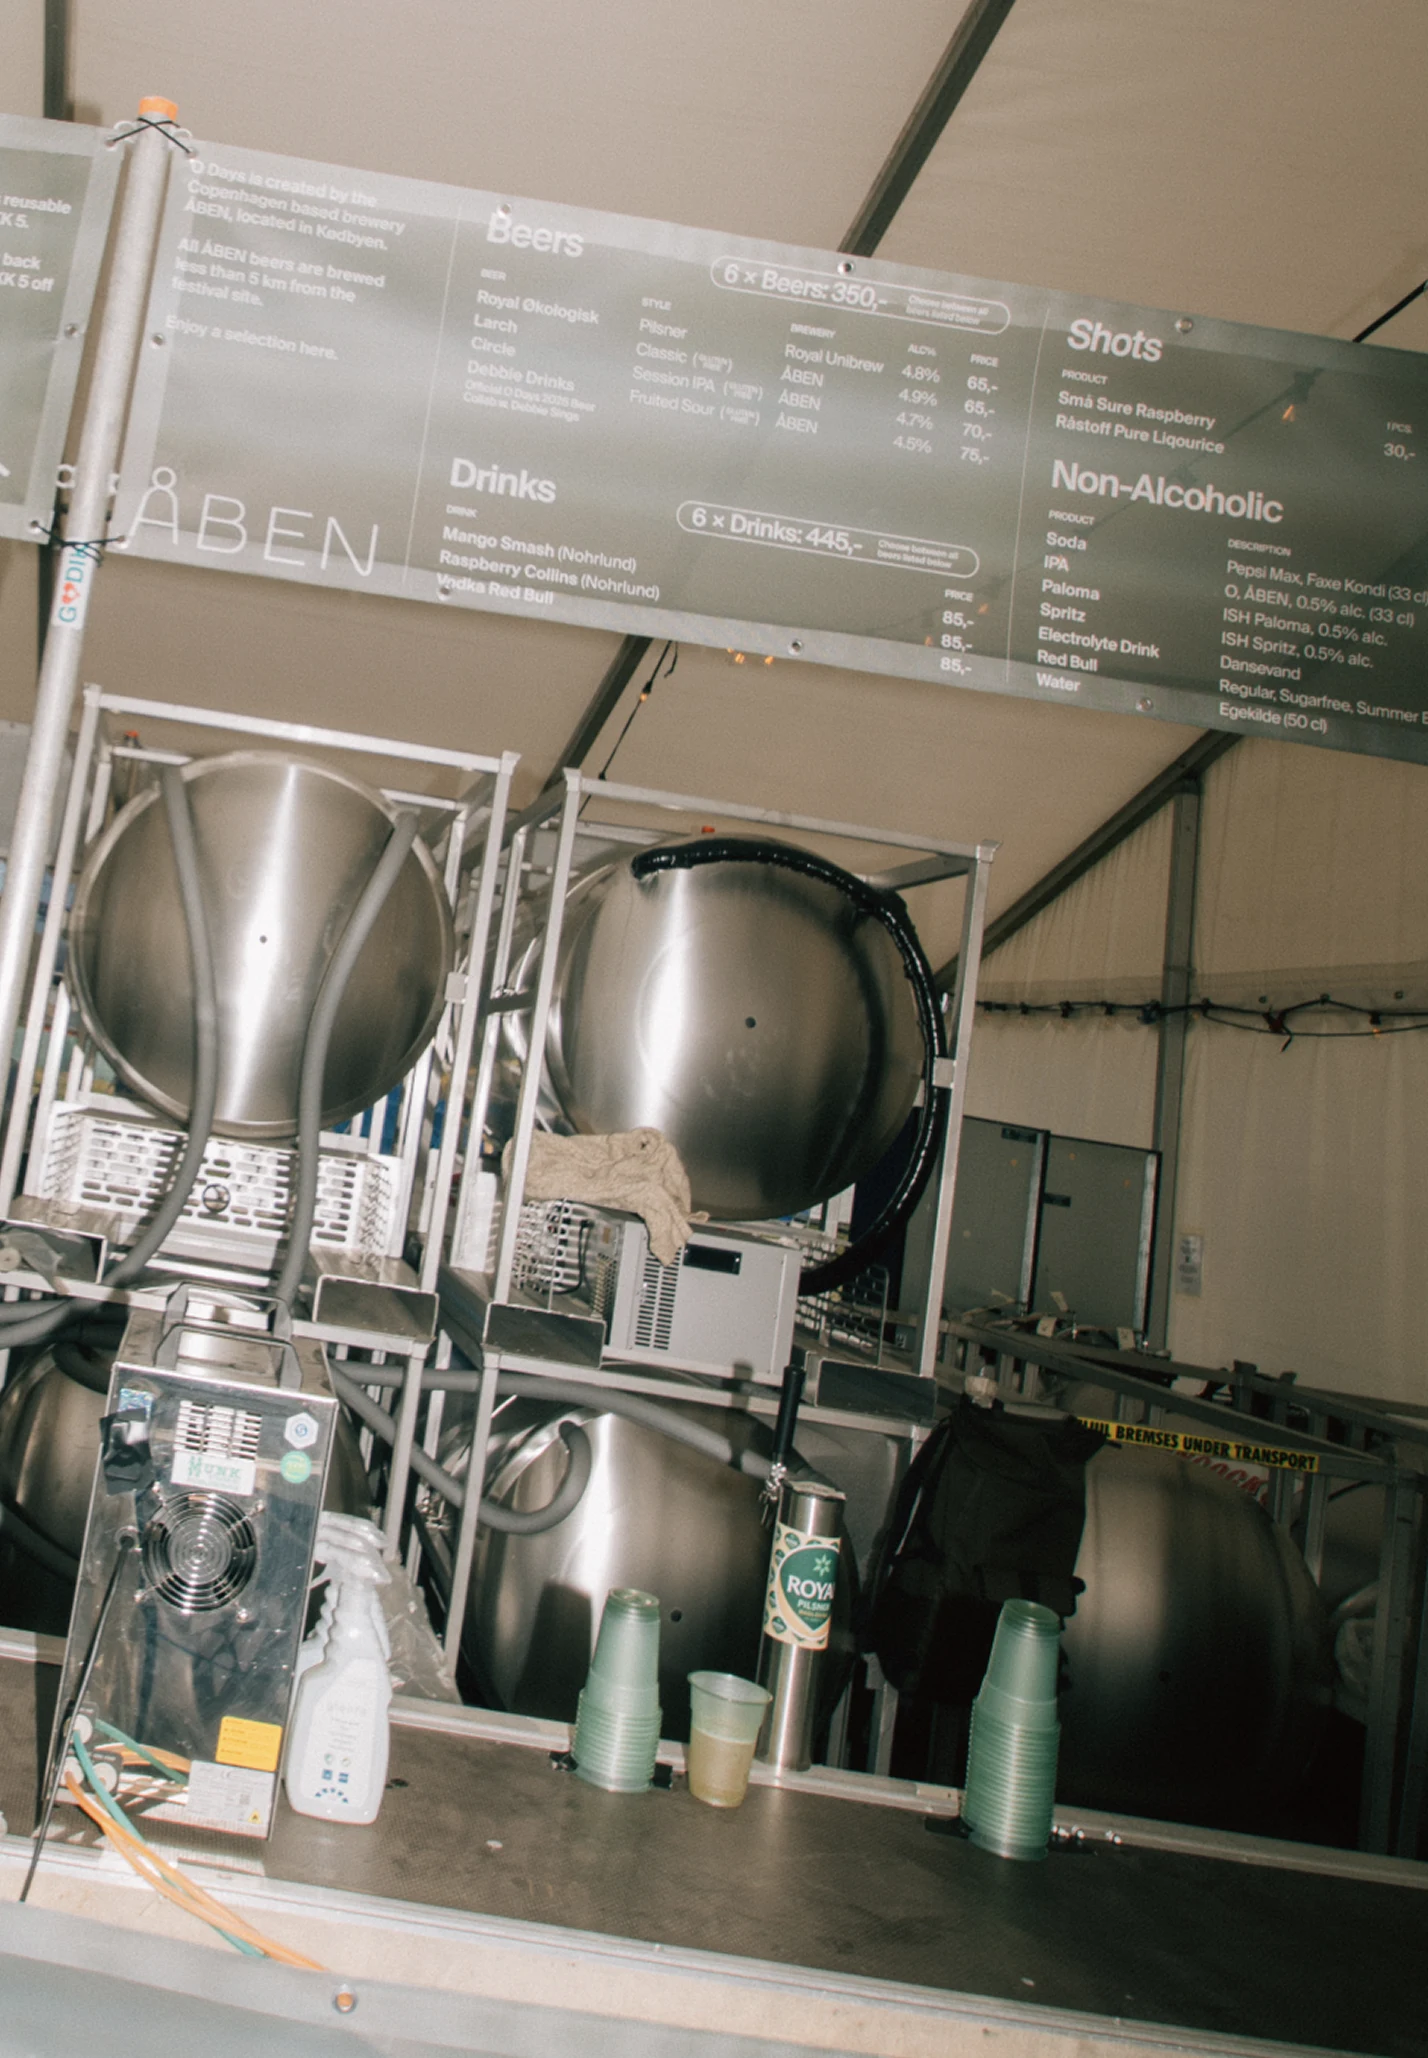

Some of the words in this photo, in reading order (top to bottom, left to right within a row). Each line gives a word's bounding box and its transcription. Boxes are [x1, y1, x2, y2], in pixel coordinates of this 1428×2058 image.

[208, 163, 246, 183] Days
[249, 174, 262, 186] is
[265, 177, 326, 198] created
[329, 186, 349, 204] by
[351, 191, 377, 207] the
[4, 196, 72, 214] reusable
[184, 197, 233, 222] ÅBEN,
[236, 207, 295, 231] located
[299, 223, 313, 235] in
[187, 180, 286, 210] Copenhagen
[291, 200, 339, 221] based
[342, 210, 406, 235] brewery
[486, 211, 584, 258] Beers
[3, 252, 41, 270] back
[177, 238, 199, 253] All
[201, 239, 247, 263] ÅBEN
[249, 251, 294, 271] beers
[297, 262, 323, 276] are
[327, 264, 385, 287] brewed
[18, 274, 30, 289] 5
[31, 278, 54, 292] off
[172, 277, 228, 299] festival
[232, 289, 264, 306] site.
[175, 256, 206, 276] less
[210, 264, 245, 282] than
[249, 271, 260, 285] 5
[262, 274, 286, 290] km
[290, 279, 327, 298] from
[330, 285, 356, 303] the
[724, 264, 738, 283] 6
[761, 270, 829, 299] Beers:
[831, 283, 888, 312] 350,-
[477, 289, 520, 310] Royal
[522, 298, 599, 324] Økologisk
[474, 314, 517, 333] Larch
[640, 318, 688, 339] Pilsner
[166, 315, 208, 337] Enjoy
[211, 326, 222, 337] a
[224, 327, 296, 352] selection
[300, 341, 338, 360] here.
[471, 336, 516, 357] Circle
[1067, 319, 1163, 363] Shots
[636, 342, 687, 364] Classic
[784, 344, 823, 364] Royal
[826, 350, 885, 373] Unibrew
[970, 354, 999, 367] PRICE
[467, 360, 522, 382] Debbie
[526, 370, 574, 391] Drinks
[633, 366, 689, 388] Session
[692, 376, 715, 392] IPA
[780, 365, 824, 387] ÅBEN
[901, 365, 940, 384] 4.8%
[967, 376, 998, 394] 65,-
[1062, 369, 1107, 385] PRODUCT
[630, 389, 679, 410] Fruited
[681, 398, 715, 415] Sour
[778, 389, 821, 411] ÅBEN
[899, 389, 937, 407] 4.9%
[964, 400, 995, 418] 65,-
[1058, 390, 1093, 409] Små
[1097, 397, 1132, 417] Sure
[1136, 403, 1216, 430] Raspberry
[775, 412, 818, 434] ÅBEN
[896, 413, 933, 430] 4.7%
[962, 423, 992, 441] 70,-
[1055, 414, 1111, 437] Råstoff
[1114, 424, 1149, 442] Pure
[1153, 429, 1225, 454] Liqourice
[1384, 443, 1416, 460] 30,-
[450, 457, 556, 504] Drinks
[1052, 459, 1284, 525] Non-Alcoholic
[126, 466, 378, 577] ÅBEN
[1048, 510, 1095, 526] PRODUCT
[692, 508, 706, 527] 6
[730, 514, 801, 544] Drinks:
[805, 527, 862, 556] 445,-
[1046, 531, 1087, 552] Soda
[442, 526, 497, 549] Mango
[501, 536, 554, 558] Smash
[558, 546, 636, 574] (Nohrlund)
[1228, 538, 1291, 556] DESCRIPTION
[440, 550, 521, 578] Raspberry
[525, 564, 577, 586] Collins
[581, 576, 660, 601] (Nohrlund)
[1044, 555, 1069, 573] IPA
[489, 582, 520, 601] Red
[524, 588, 553, 605] Bull
[1042, 579, 1100, 601] Paloma
[1227, 560, 1267, 579] Pepsi
[1270, 567, 1304, 586] Max,
[1307, 572, 1341, 590] Faxe
[1344, 579, 1386, 597] Kondi
[1388, 585, 1411, 602] (33
[945, 589, 973, 602] PRICE
[1244, 584, 1292, 608] ÅBEN,
[1296, 595, 1337, 614] 0.5%
[1369, 606, 1394, 623] (33
[1396, 612, 1415, 628] cl)
[942, 611, 974, 628] 85,-
[1040, 603, 1086, 623] Spritz
[1223, 608, 1251, 624] ISH
[1255, 612, 1314, 635] Paloma,
[1318, 623, 1359, 642] 0.5%
[1362, 629, 1389, 646] alc.
[941, 634, 972, 652] 85,-
[1038, 626, 1118, 652] Electrolyte
[1120, 640, 1160, 659] Drink
[1221, 631, 1249, 648] ISH
[1252, 636, 1300, 658] Spritz,
[1304, 645, 1344, 664] 0.5%
[1348, 651, 1374, 668] alc.
[940, 657, 972, 675] 85,-
[1037, 650, 1067, 667] Red
[1070, 654, 1098, 672] Bull
[1220, 655, 1301, 680] Dansevand
[1036, 673, 1081, 693] Water
[1219, 679, 1277, 701] Regular,
[1279, 688, 1354, 714] Sugarfree,
[1357, 701, 1418, 723] Summer
[1219, 702, 1281, 725] Egekilde
[1283, 713, 1308, 729] (50
[1311, 719, 1328, 734] cl)
[1116, 1425, 1179, 1448] BREMSES
[1184, 1438, 1230, 1457] UNDER
[1234, 1444, 1316, 1470] TRANSPORT
[787, 1575, 835, 1601] ROYA
